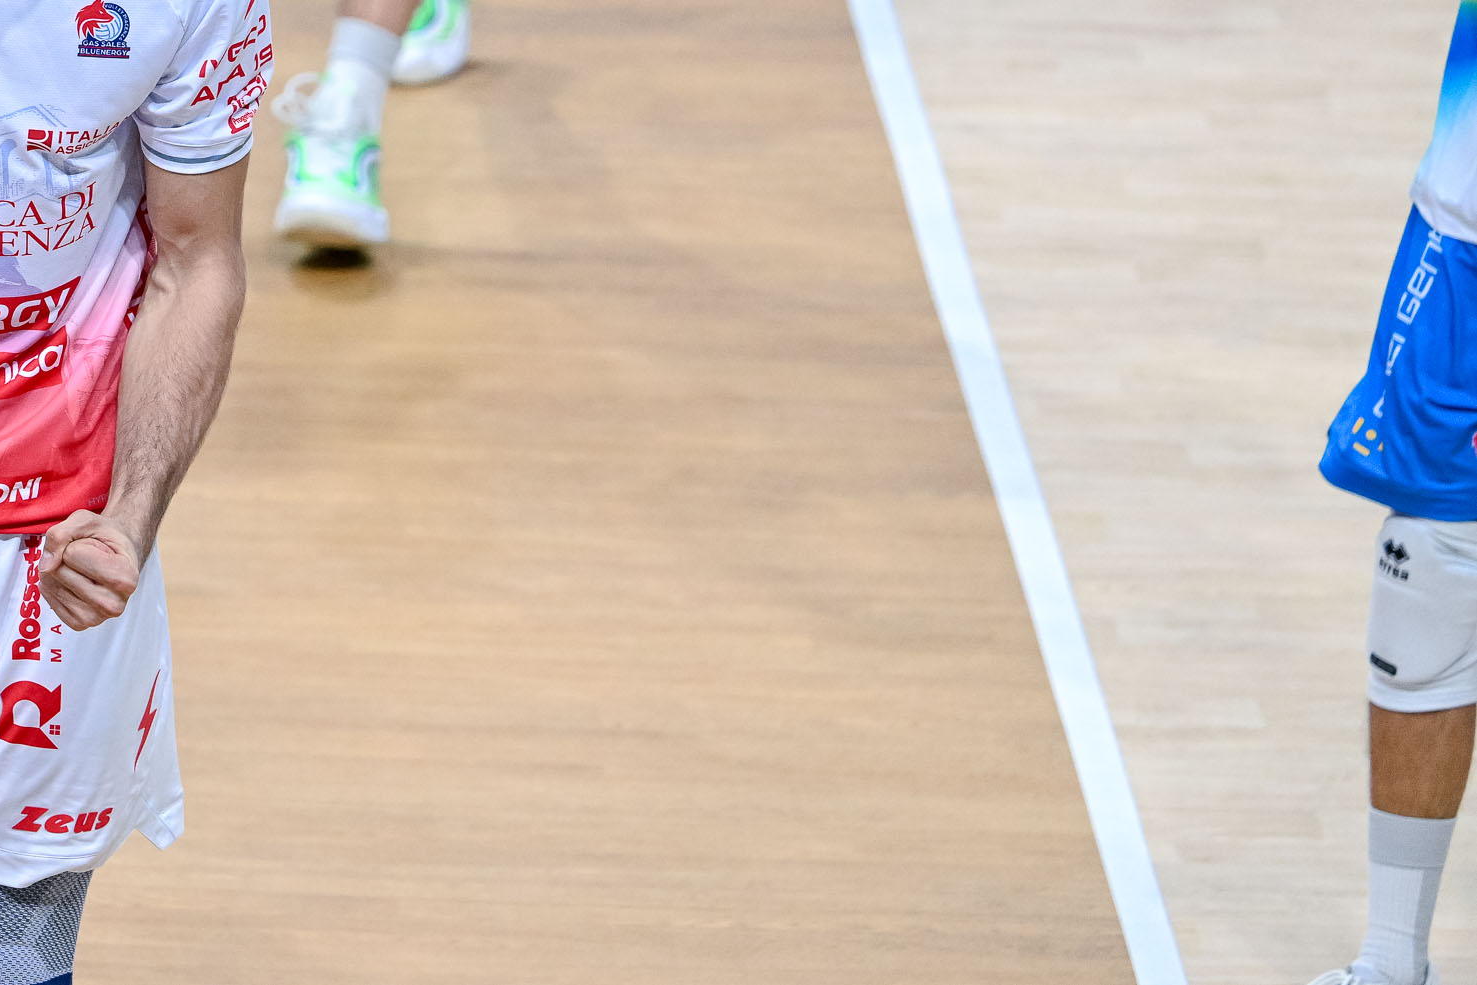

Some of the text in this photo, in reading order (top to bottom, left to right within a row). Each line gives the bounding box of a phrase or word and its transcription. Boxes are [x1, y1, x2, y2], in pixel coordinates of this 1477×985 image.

[79, 47, 128, 56] BLUENERGY
[82, 39, 127, 48] GAS SALES
[58, 121, 120, 144] ITALIA
[58, 181, 97, 221] DI
[12, 535, 44, 661] Rossett
[12, 805, 114, 834] Zeus
